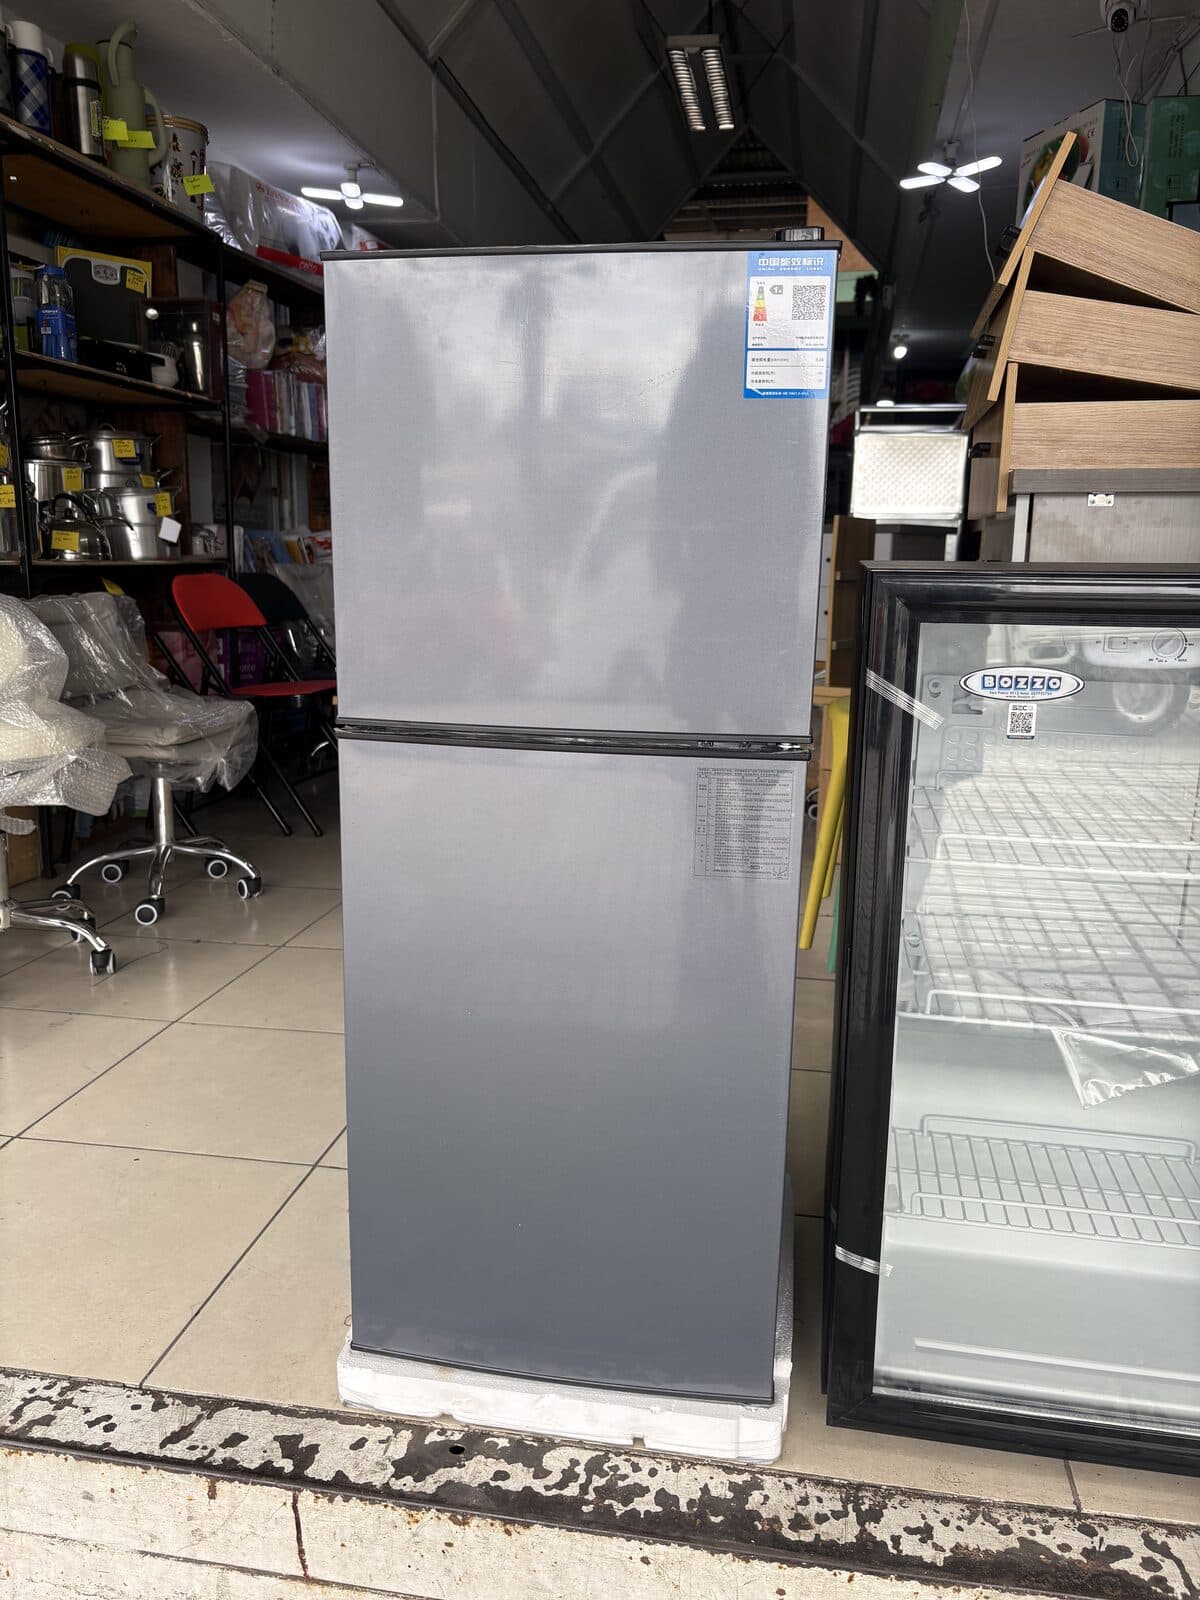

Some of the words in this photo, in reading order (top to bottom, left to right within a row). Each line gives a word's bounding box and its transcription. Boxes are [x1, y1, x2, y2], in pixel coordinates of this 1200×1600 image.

[758, 257, 824, 266] 中国能效标识
[981, 674, 1062, 691] BOZZO
